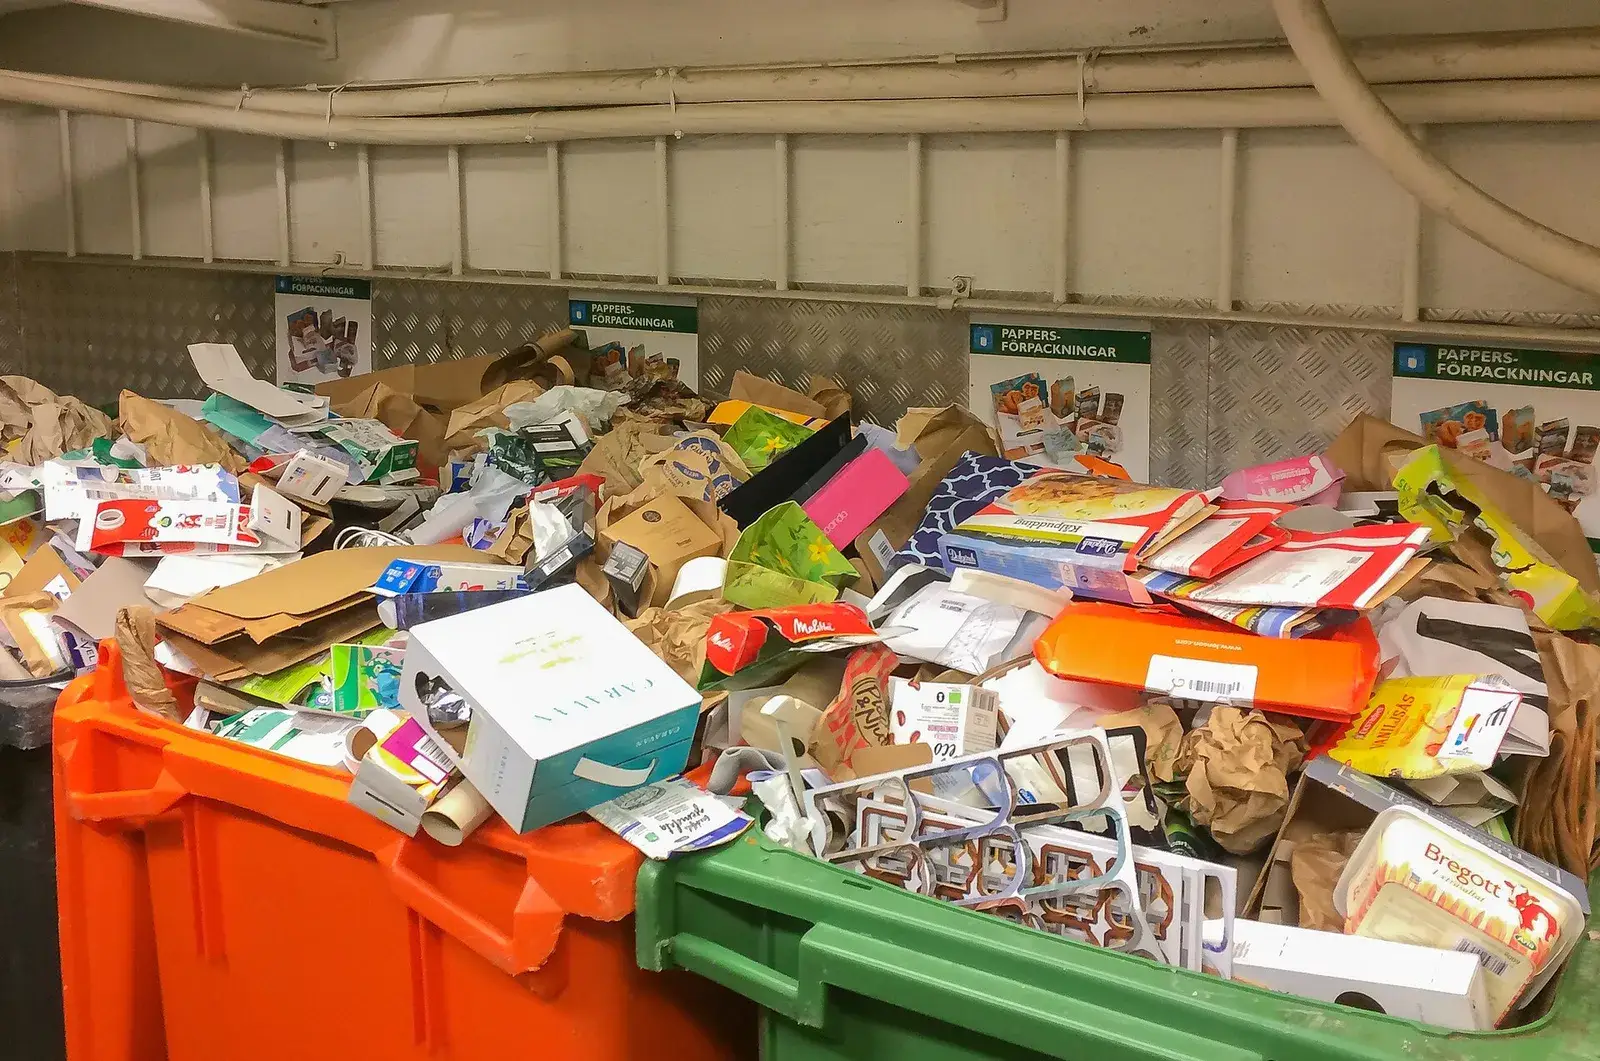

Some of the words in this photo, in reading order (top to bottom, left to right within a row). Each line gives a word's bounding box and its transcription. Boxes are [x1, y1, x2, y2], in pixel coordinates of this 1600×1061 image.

[591, 303, 635, 314] PAPPERS-
[1001, 328, 1061, 341] PAPPERS-
[1001, 340, 1116, 357] FÖRPACKNINGAR
[1437, 348, 1519, 364] PAPPERS-
[1436, 361, 1594, 385] FÖRPACKNINGAR
[1014, 516, 1083, 533] Kålpudding
[793, 618, 836, 635] Melitta
[1424, 842, 1502, 899] Bregott
